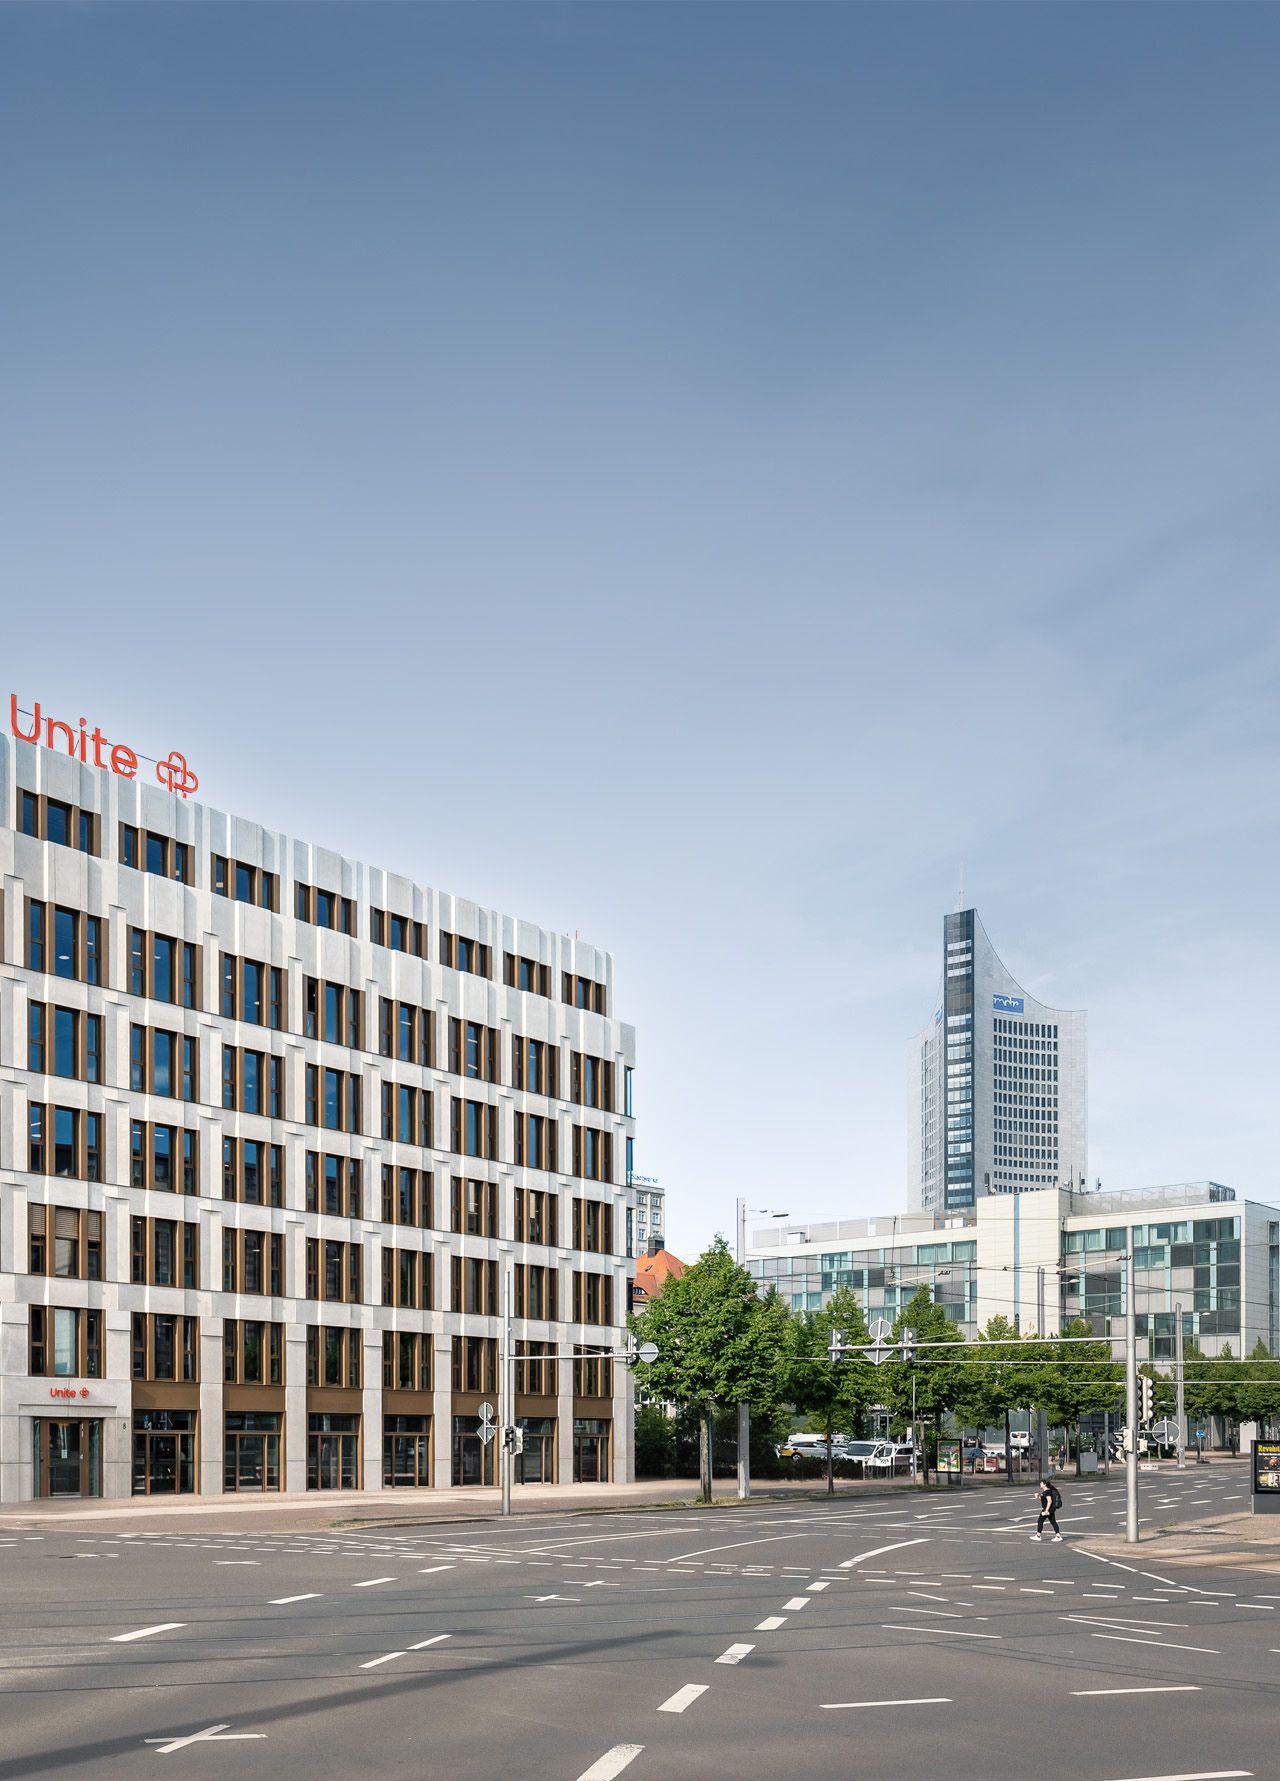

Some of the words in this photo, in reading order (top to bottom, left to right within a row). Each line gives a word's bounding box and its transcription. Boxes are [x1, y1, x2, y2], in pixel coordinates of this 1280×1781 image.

[10, 693, 138, 779] Unite
[993, 996, 1019, 1008] mdr
[50, 1388, 76, 1398] Unite
